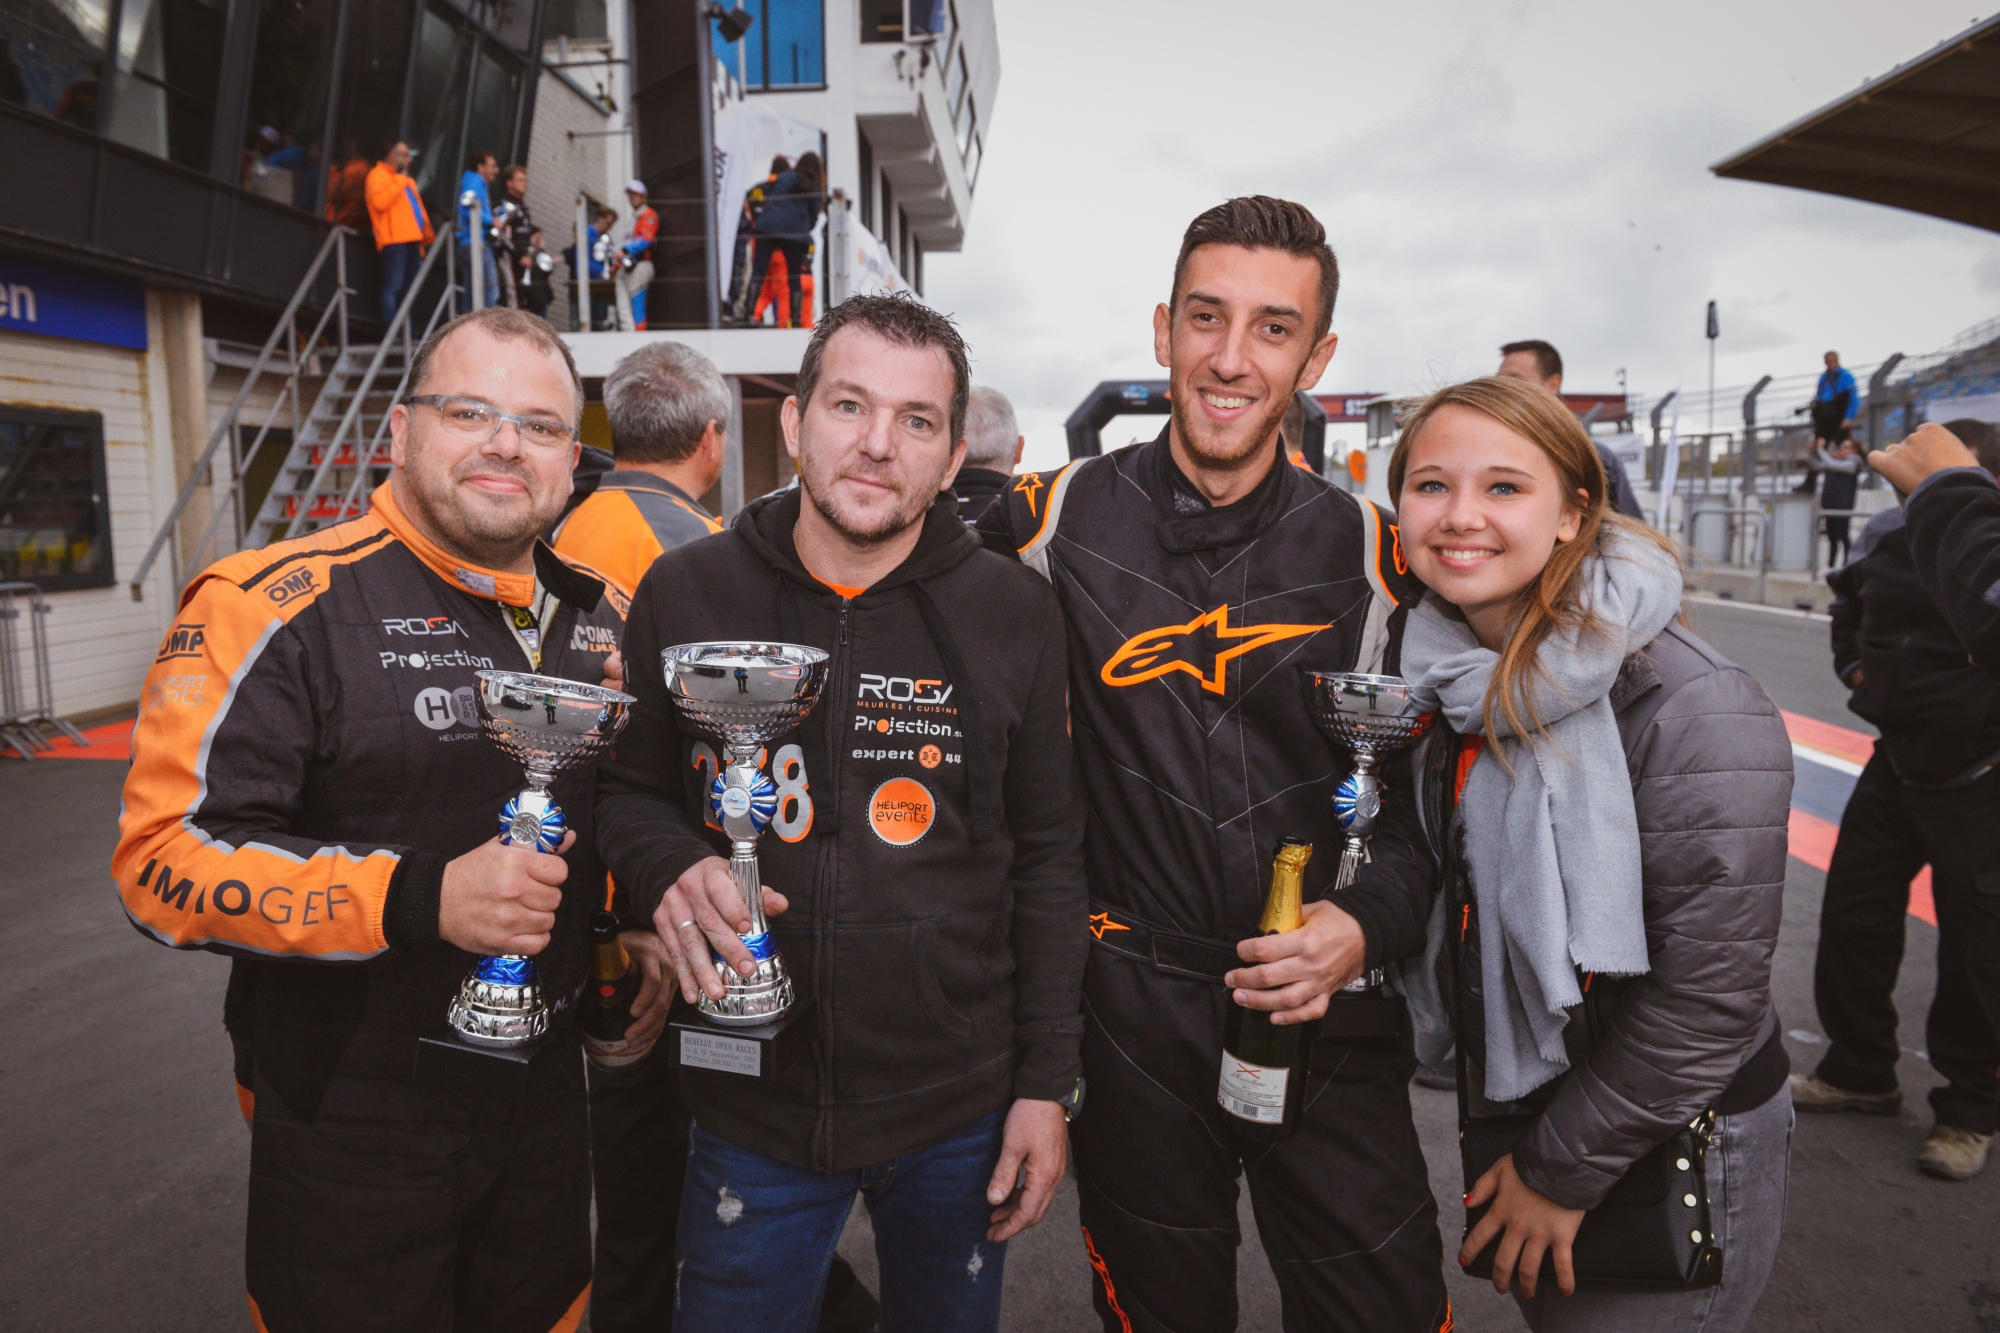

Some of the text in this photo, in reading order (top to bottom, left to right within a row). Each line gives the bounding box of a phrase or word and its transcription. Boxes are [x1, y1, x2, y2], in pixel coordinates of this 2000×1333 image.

[269, 569, 314, 602] OMP
[379, 650, 494, 670] Projection
[424, 695, 450, 721] H
[857, 701, 903, 710] MEUBLES
[852, 749, 962, 764] expert 44
[876, 799, 928, 812] HÉLIPORT
[875, 808, 927, 823] events
[684, 1036, 757, 1055] BENELUX OPEN RACES
[709, 1050, 740, 1061] September
